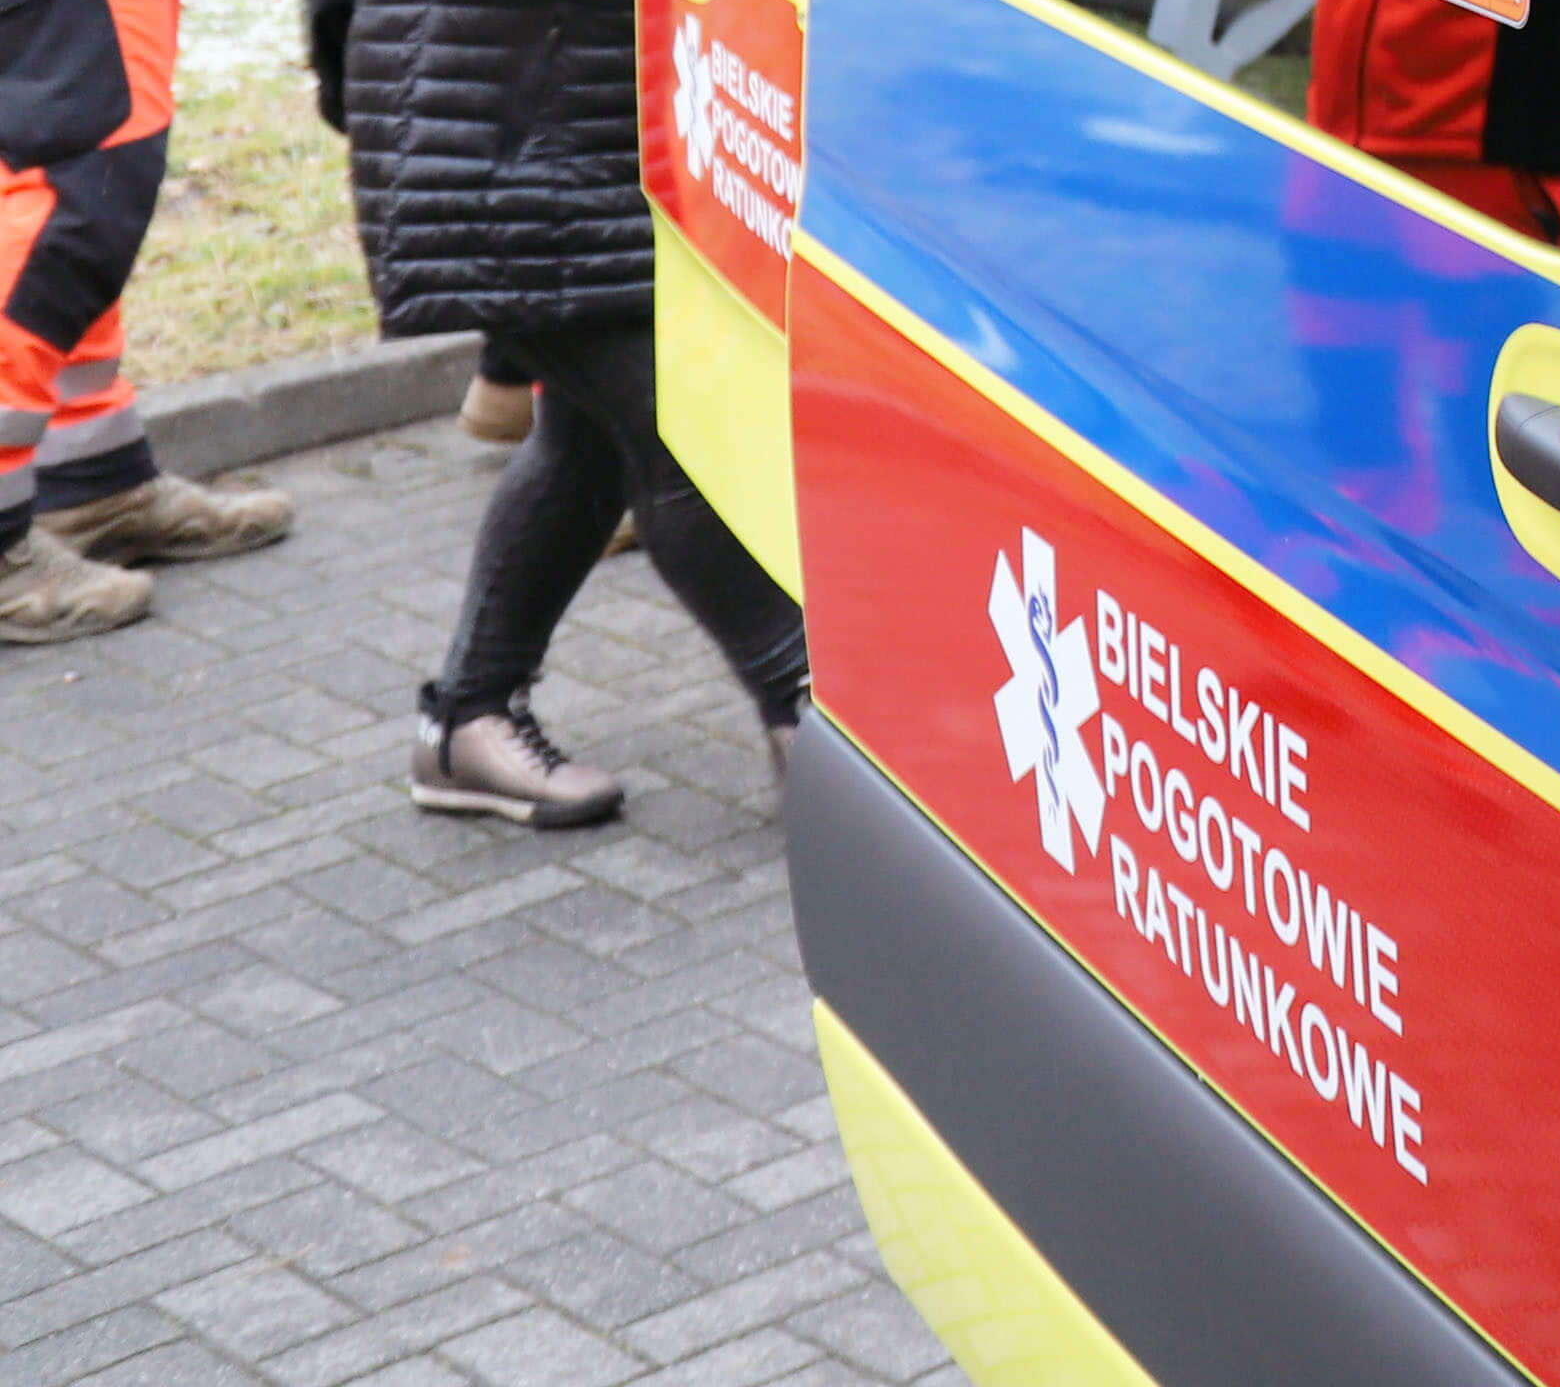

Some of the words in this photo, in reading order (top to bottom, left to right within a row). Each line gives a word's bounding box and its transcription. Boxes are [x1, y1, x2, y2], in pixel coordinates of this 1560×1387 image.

[711, 39, 795, 143] BIELSKIE
[1096, 588, 1311, 833] BIELSKIE
[1101, 712, 1403, 1038] POGOTOWIE
[1110, 834, 1428, 1186] RATUNKOWE
